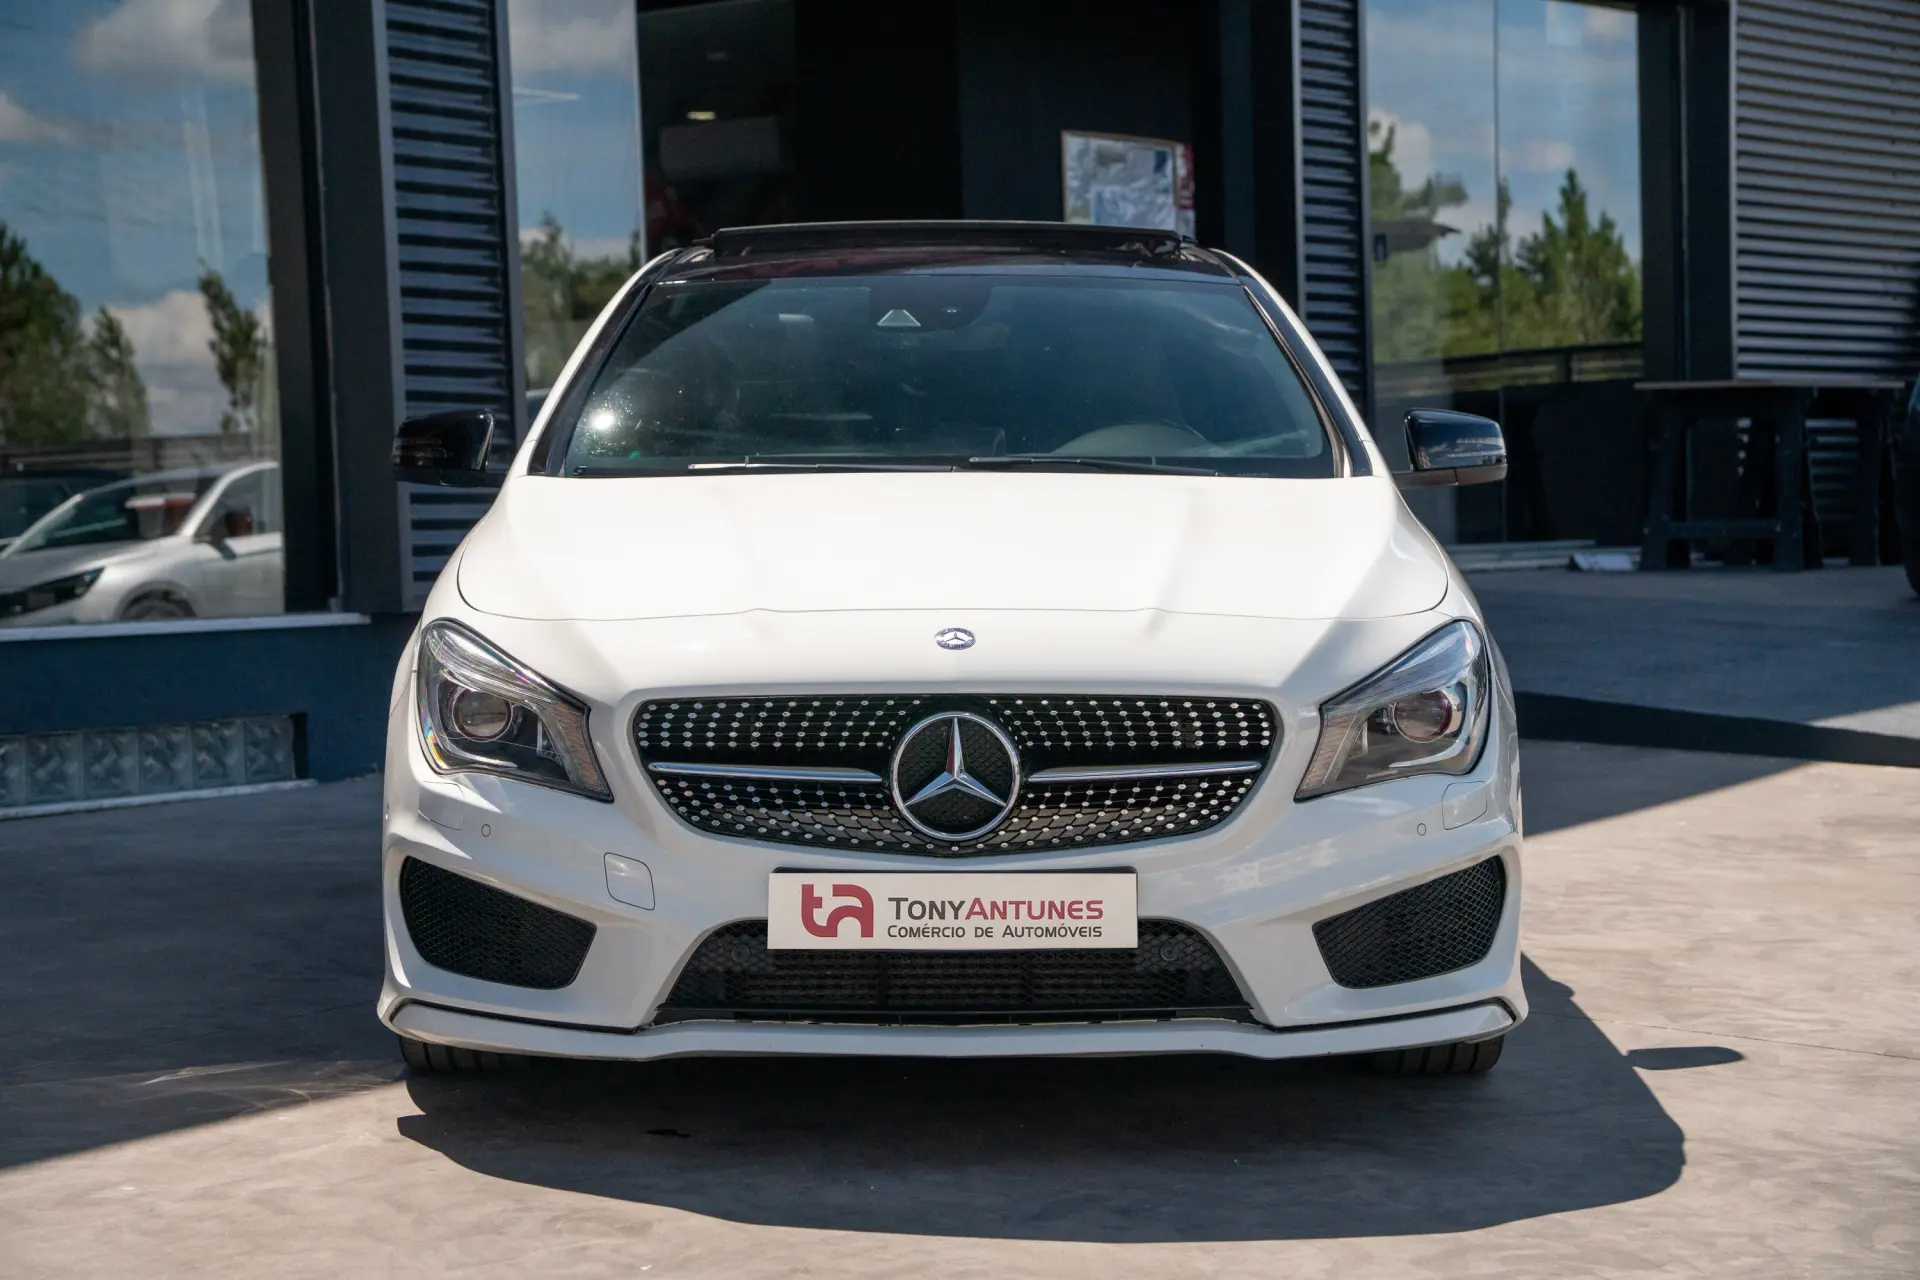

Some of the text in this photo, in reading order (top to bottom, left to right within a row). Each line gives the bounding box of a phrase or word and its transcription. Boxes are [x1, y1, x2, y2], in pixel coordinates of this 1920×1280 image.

[887, 923, 1103, 938] COMÉRCIO DE AUTOMÓVEIS
